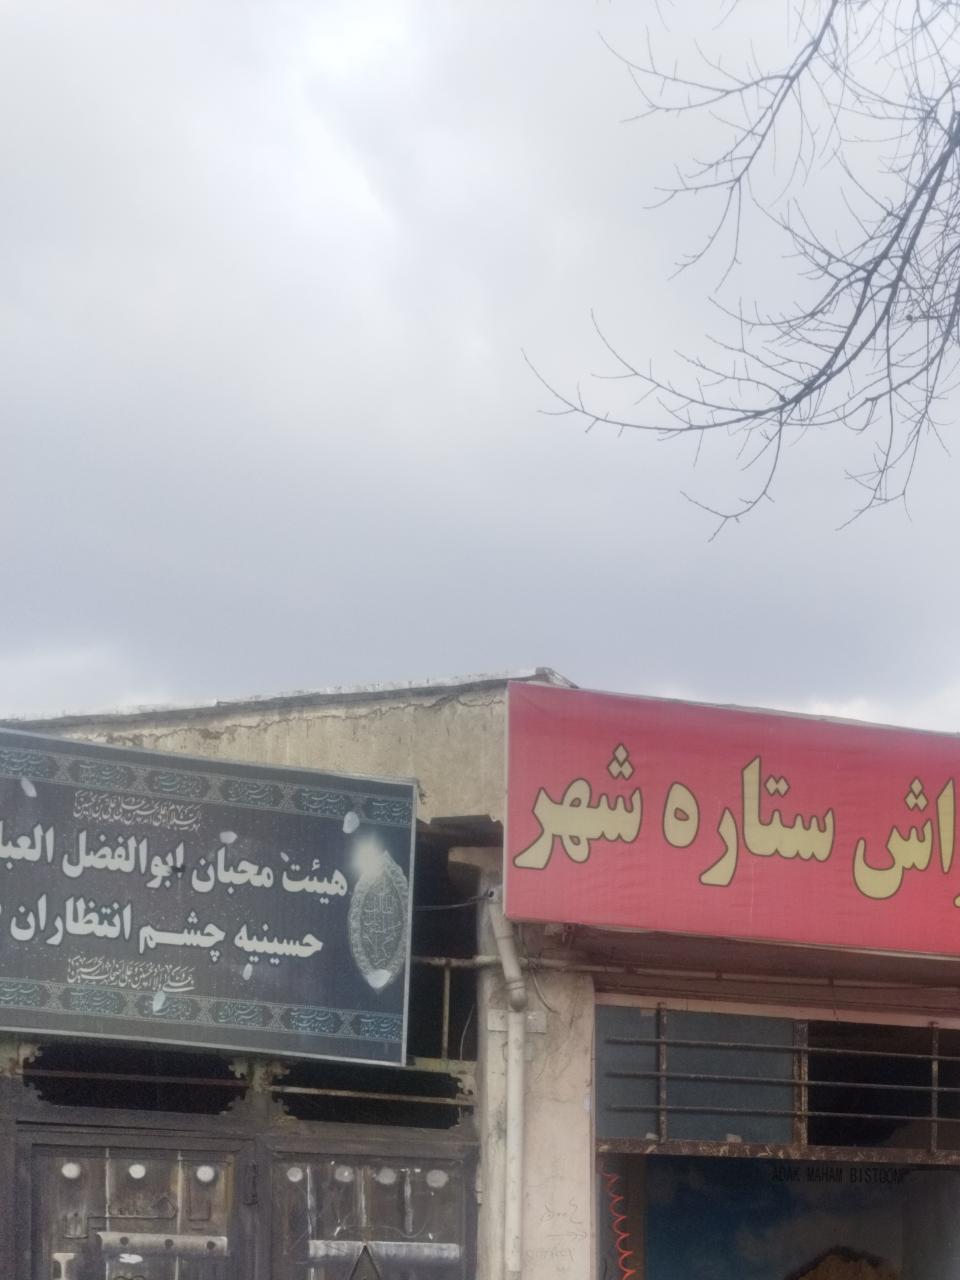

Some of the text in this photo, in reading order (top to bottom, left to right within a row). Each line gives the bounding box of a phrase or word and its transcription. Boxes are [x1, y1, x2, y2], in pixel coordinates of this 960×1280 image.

[512, 743, 643, 870] شهر
[662, 756, 836, 887] ستاره
[192, 847, 274, 894] محبان
[10, 893, 324, 965] حسینیه چشم انتظاران
